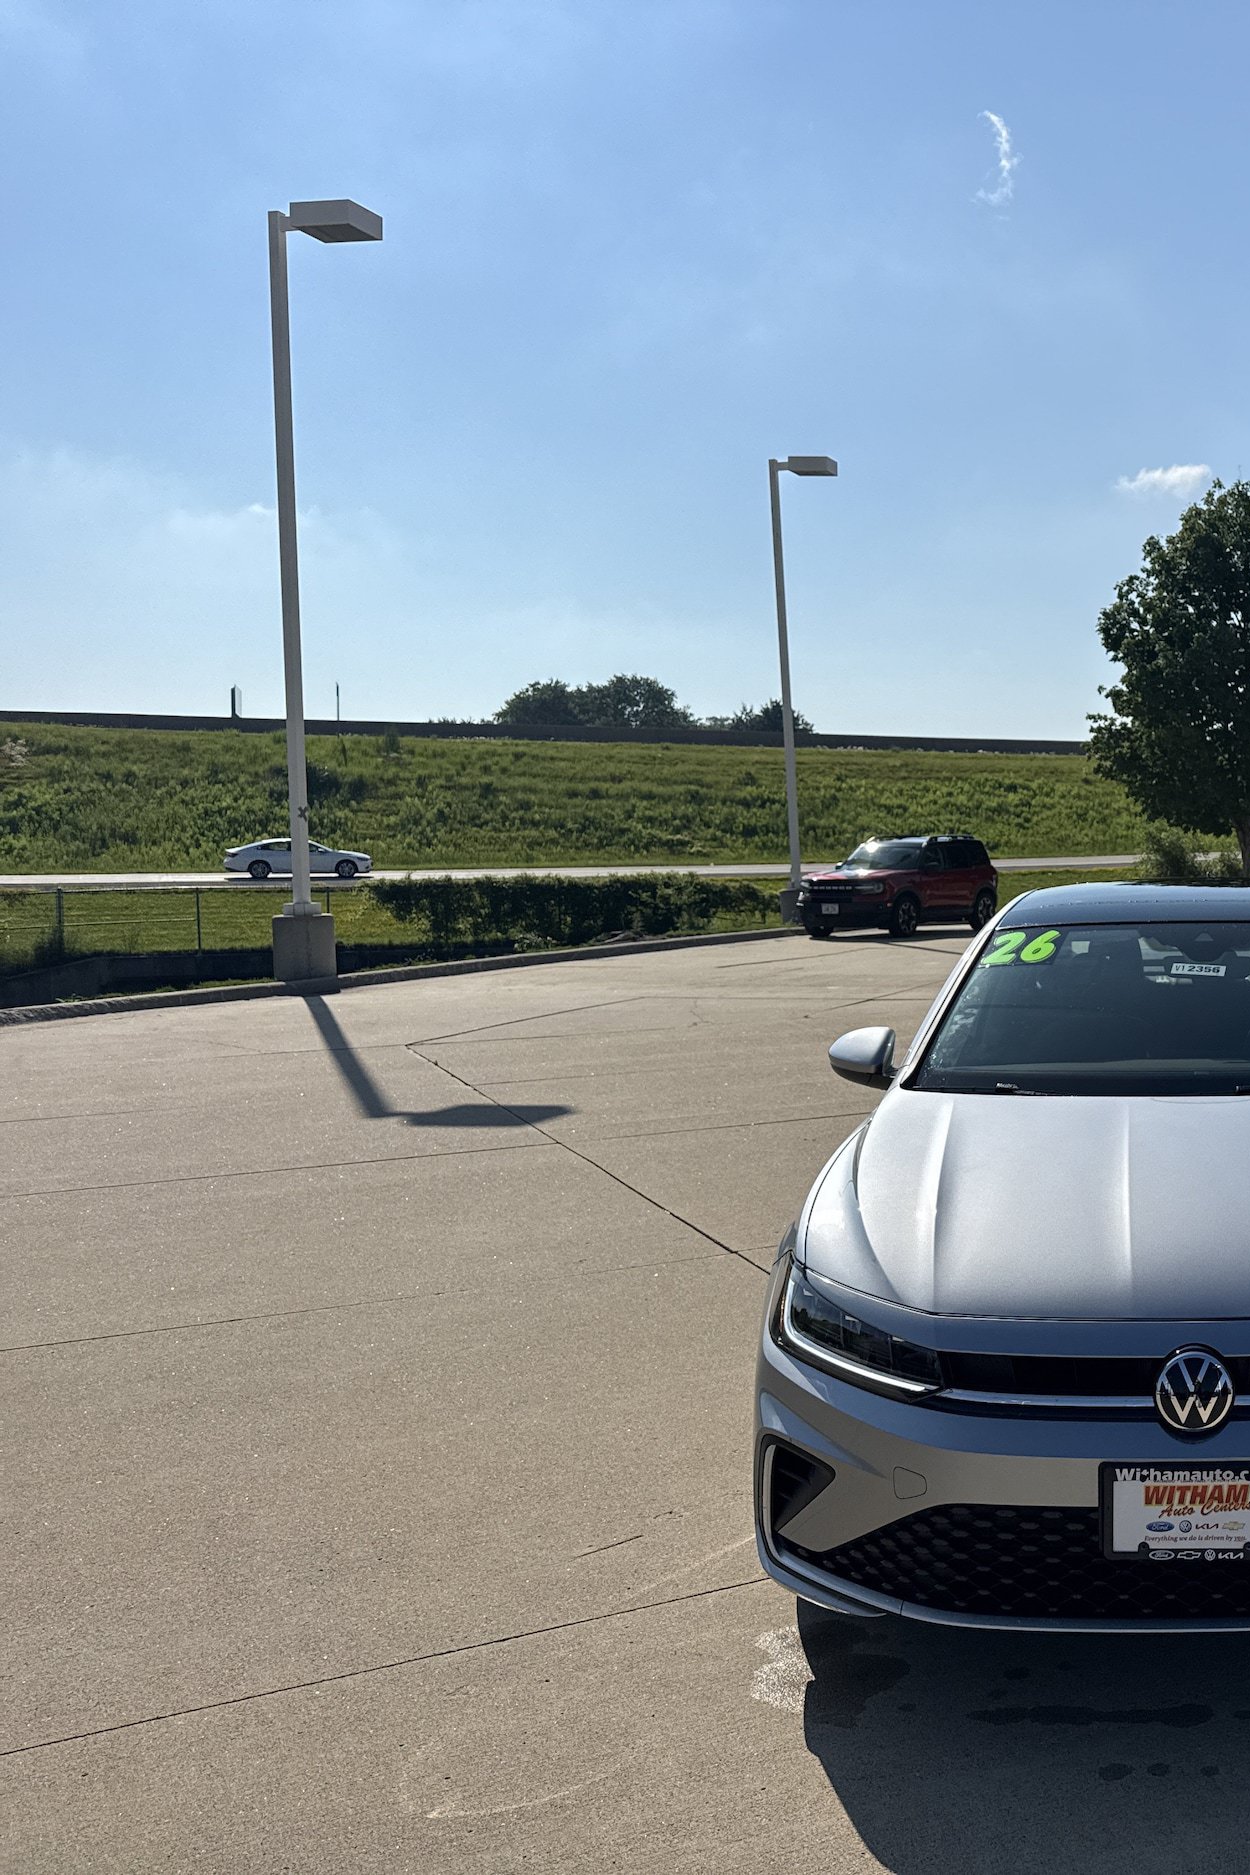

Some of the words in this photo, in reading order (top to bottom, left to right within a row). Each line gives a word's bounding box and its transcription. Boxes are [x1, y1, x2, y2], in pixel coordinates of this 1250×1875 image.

[980, 929, 1061, 965] 26
[1144, 1485, 1250, 1506] WITHAM
[1159, 1504, 1195, 1518] Auto
